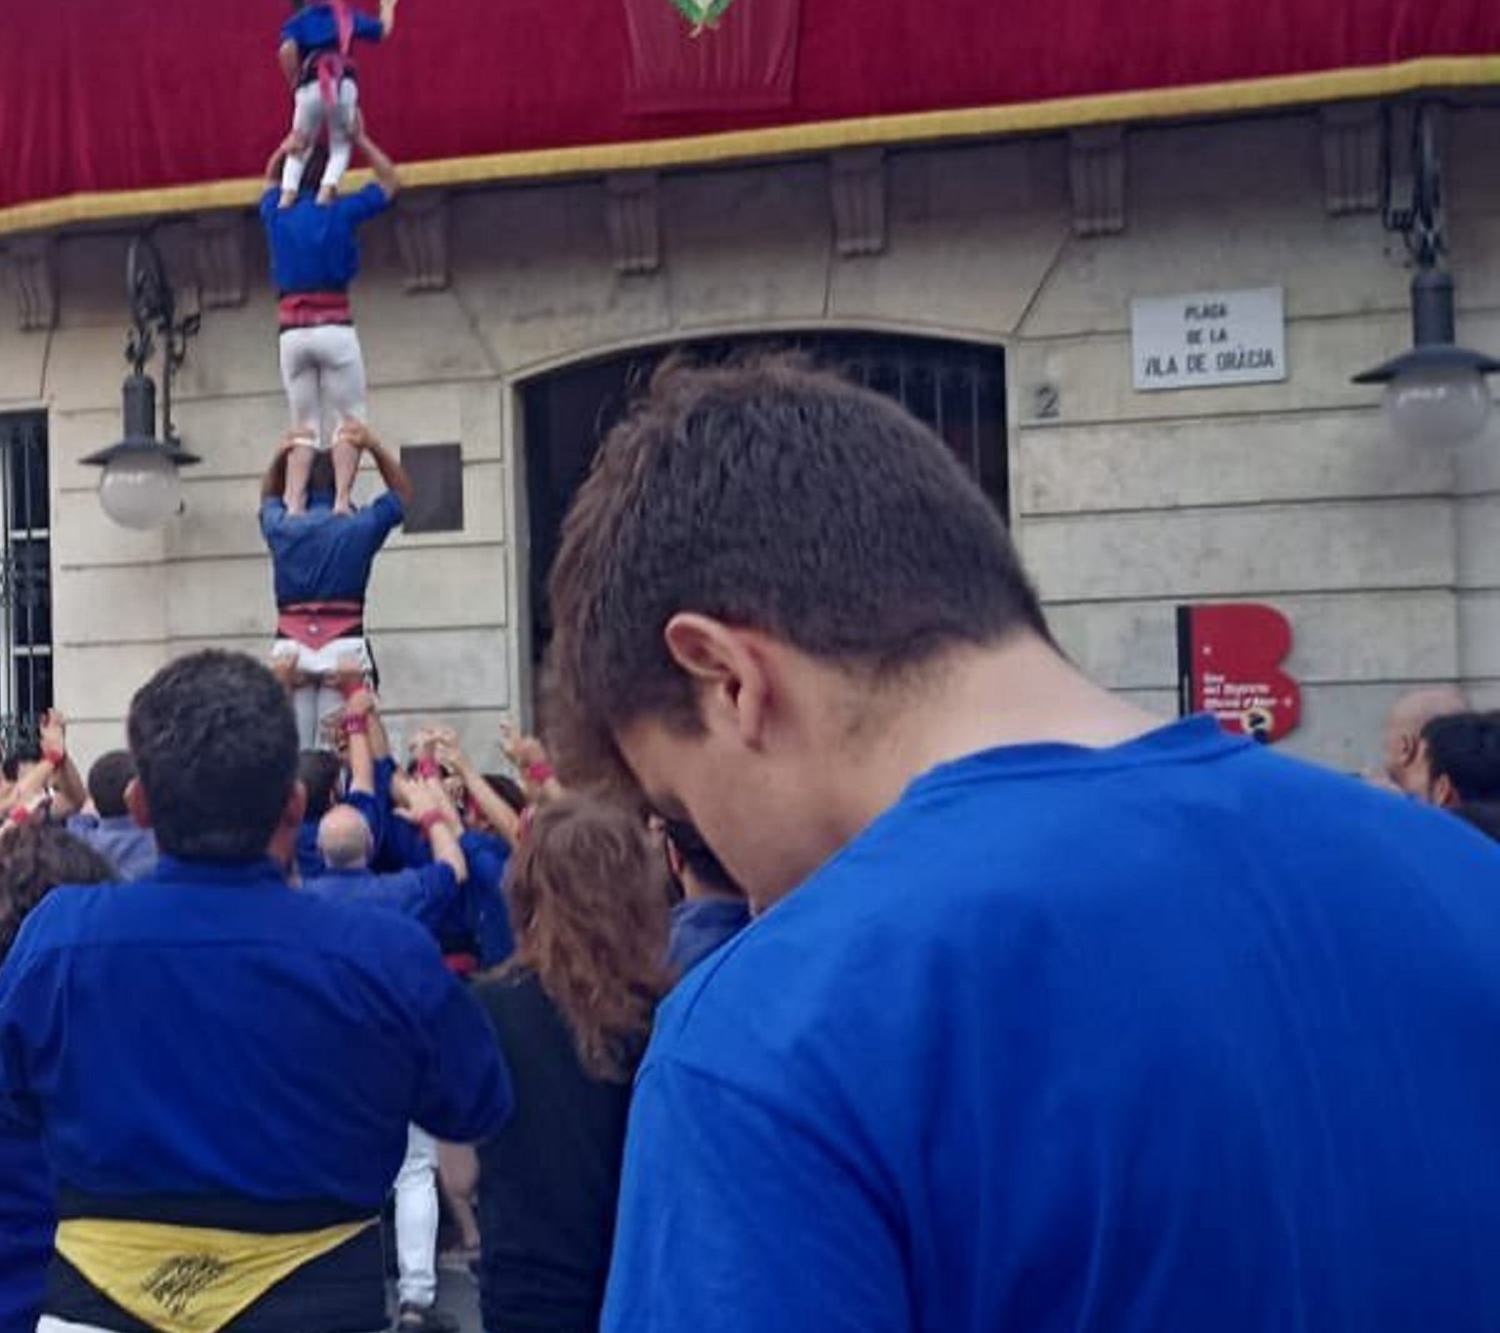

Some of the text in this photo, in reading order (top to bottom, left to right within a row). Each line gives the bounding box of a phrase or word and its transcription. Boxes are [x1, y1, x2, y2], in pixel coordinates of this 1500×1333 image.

[1209, 328, 1228, 343] LA
[1186, 352, 1206, 373] DE
[1035, 384, 1060, 419] 2
